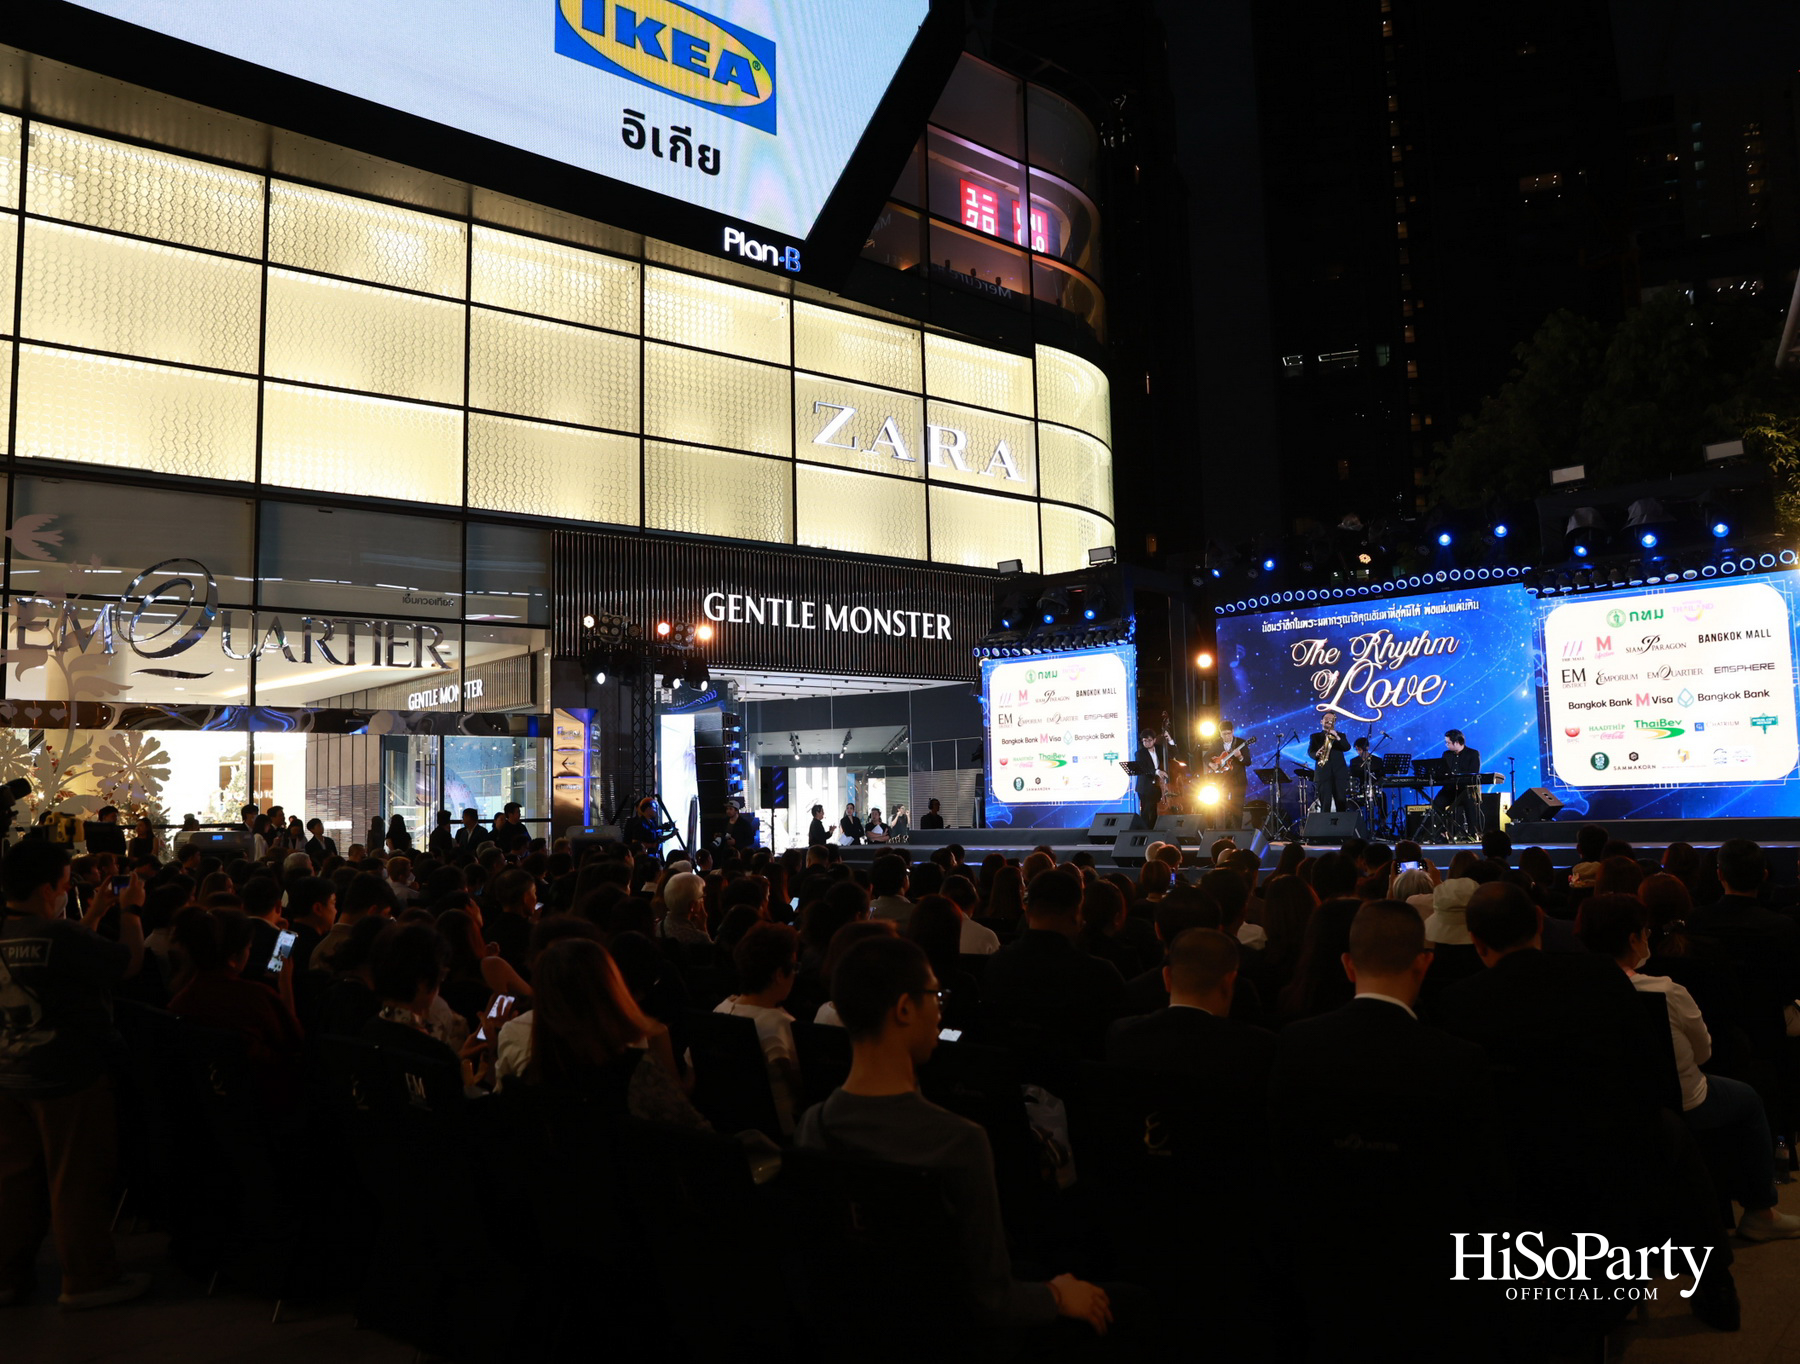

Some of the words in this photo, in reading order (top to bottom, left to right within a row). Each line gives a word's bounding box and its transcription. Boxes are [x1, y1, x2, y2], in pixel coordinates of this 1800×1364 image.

[581, 0, 760, 99] IKEA
[621, 108, 721, 176] อิเกีย
[812, 401, 1026, 483] ZARA
[703, 592, 816, 630] GENTLE
[824, 603, 952, 641] MONSTER
[1629, 608, 1664, 622] กทม
[1698, 631, 1742, 643] BANGKOK
[1745, 629, 1771, 639] MALL
[1290, 637, 1341, 667] The
[1349, 629, 1460, 670] Rhythm
[1596, 635, 1612, 651] M
[1625, 646, 1644, 654] SIAM
[1652, 642, 1687, 652] PARAGON
[1647, 664, 1704, 680] EMQUARTIER
[1713, 662, 1776, 674] EMSPHERE
[1038, 670, 1058, 680] กทม
[1561, 668, 1586, 683] EM
[1018, 689, 1028, 701] M
[1075, 688, 1101, 698] BANGKOK
[1102, 687, 1117, 696] MALL
[1316, 659, 1448, 722] Love
[1697, 691, 1742, 702] Bangkok
[1743, 689, 1771, 699] Bank
[408, 688, 439, 711] GENTLE
[1568, 700, 1608, 711] Bangkok
[1609, 698, 1633, 707] Bank
[1635, 693, 1650, 707] M
[1651, 695, 1674, 705] Visa
[998, 713, 1013, 725] EM
[1084, 712, 1118, 721] EMSPHERE
[1633, 718, 1683, 729] ThaiBev
[1001, 738, 1024, 746] Bangkok
[1074, 734, 1099, 742] Bangkok
[1100, 732, 1115, 740] Bank
[1038, 753, 1066, 761] ThaiBev
